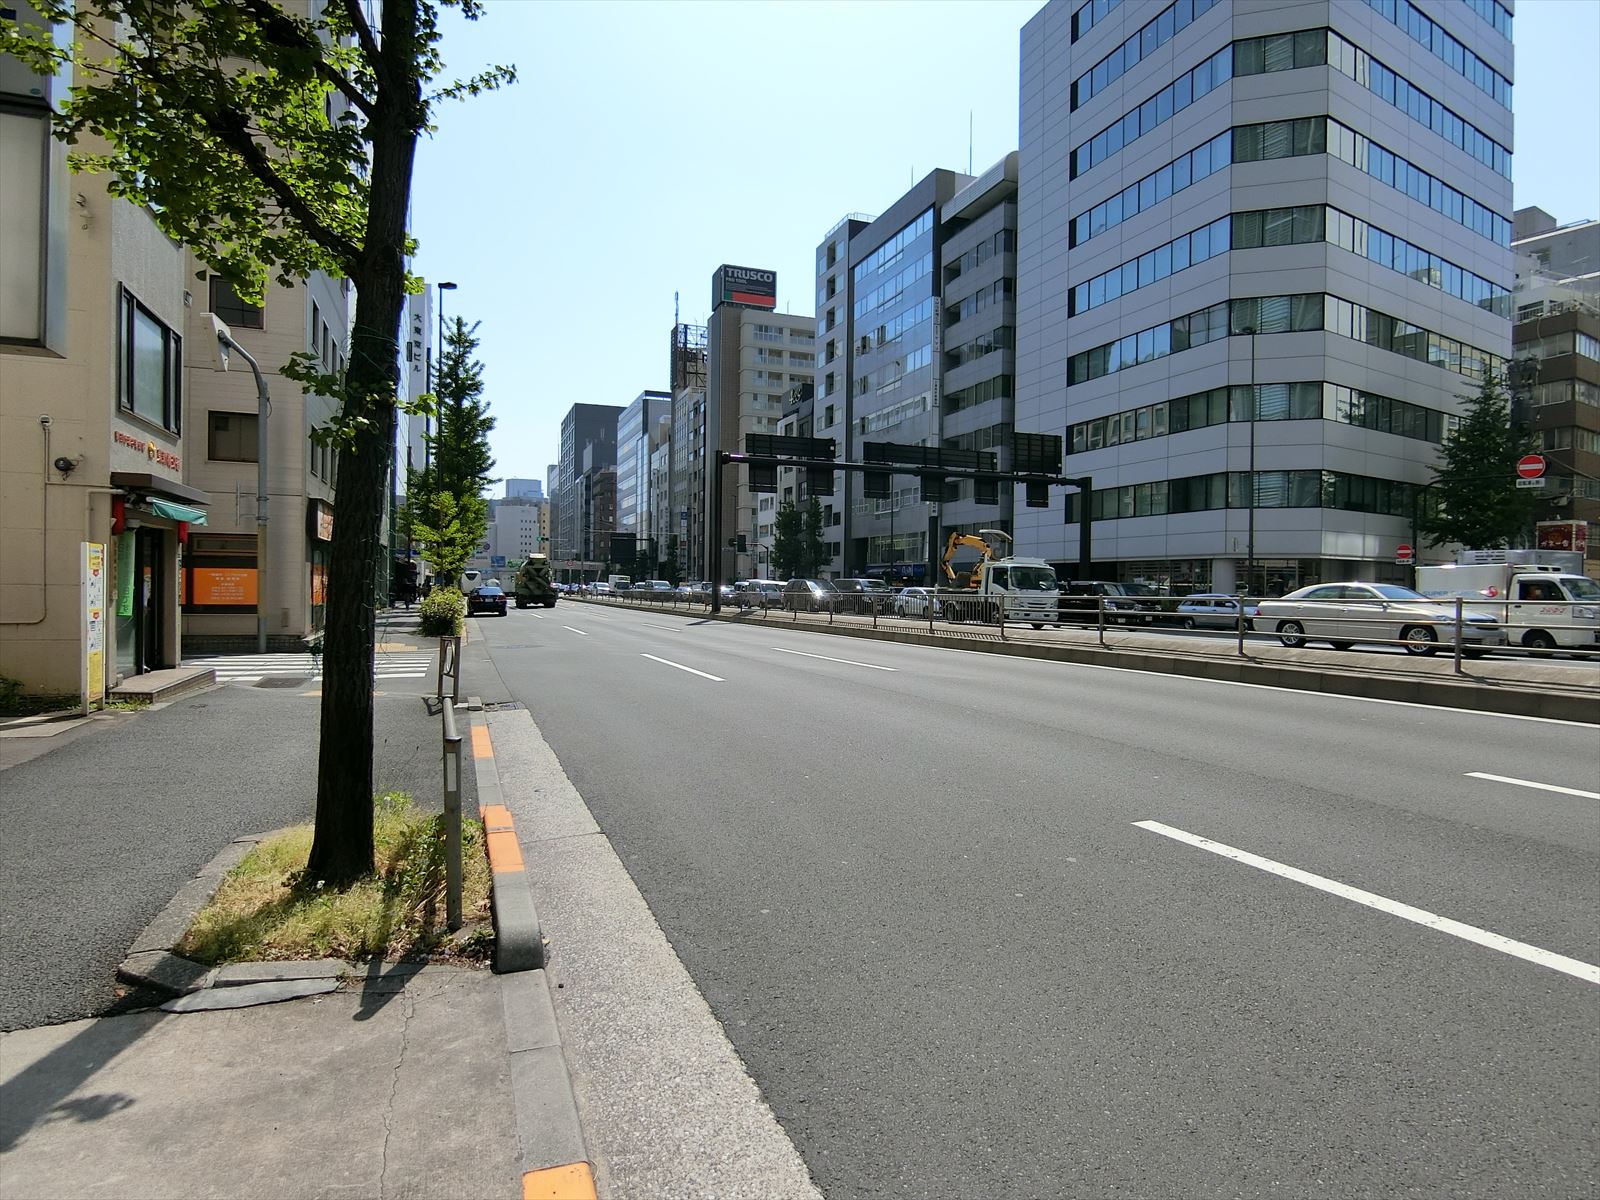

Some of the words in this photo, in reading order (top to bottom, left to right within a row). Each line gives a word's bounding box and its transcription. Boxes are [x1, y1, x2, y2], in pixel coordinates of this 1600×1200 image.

[726, 267, 773, 282] TRUSCO
[413, 313, 422, 373] 大東京ビル
